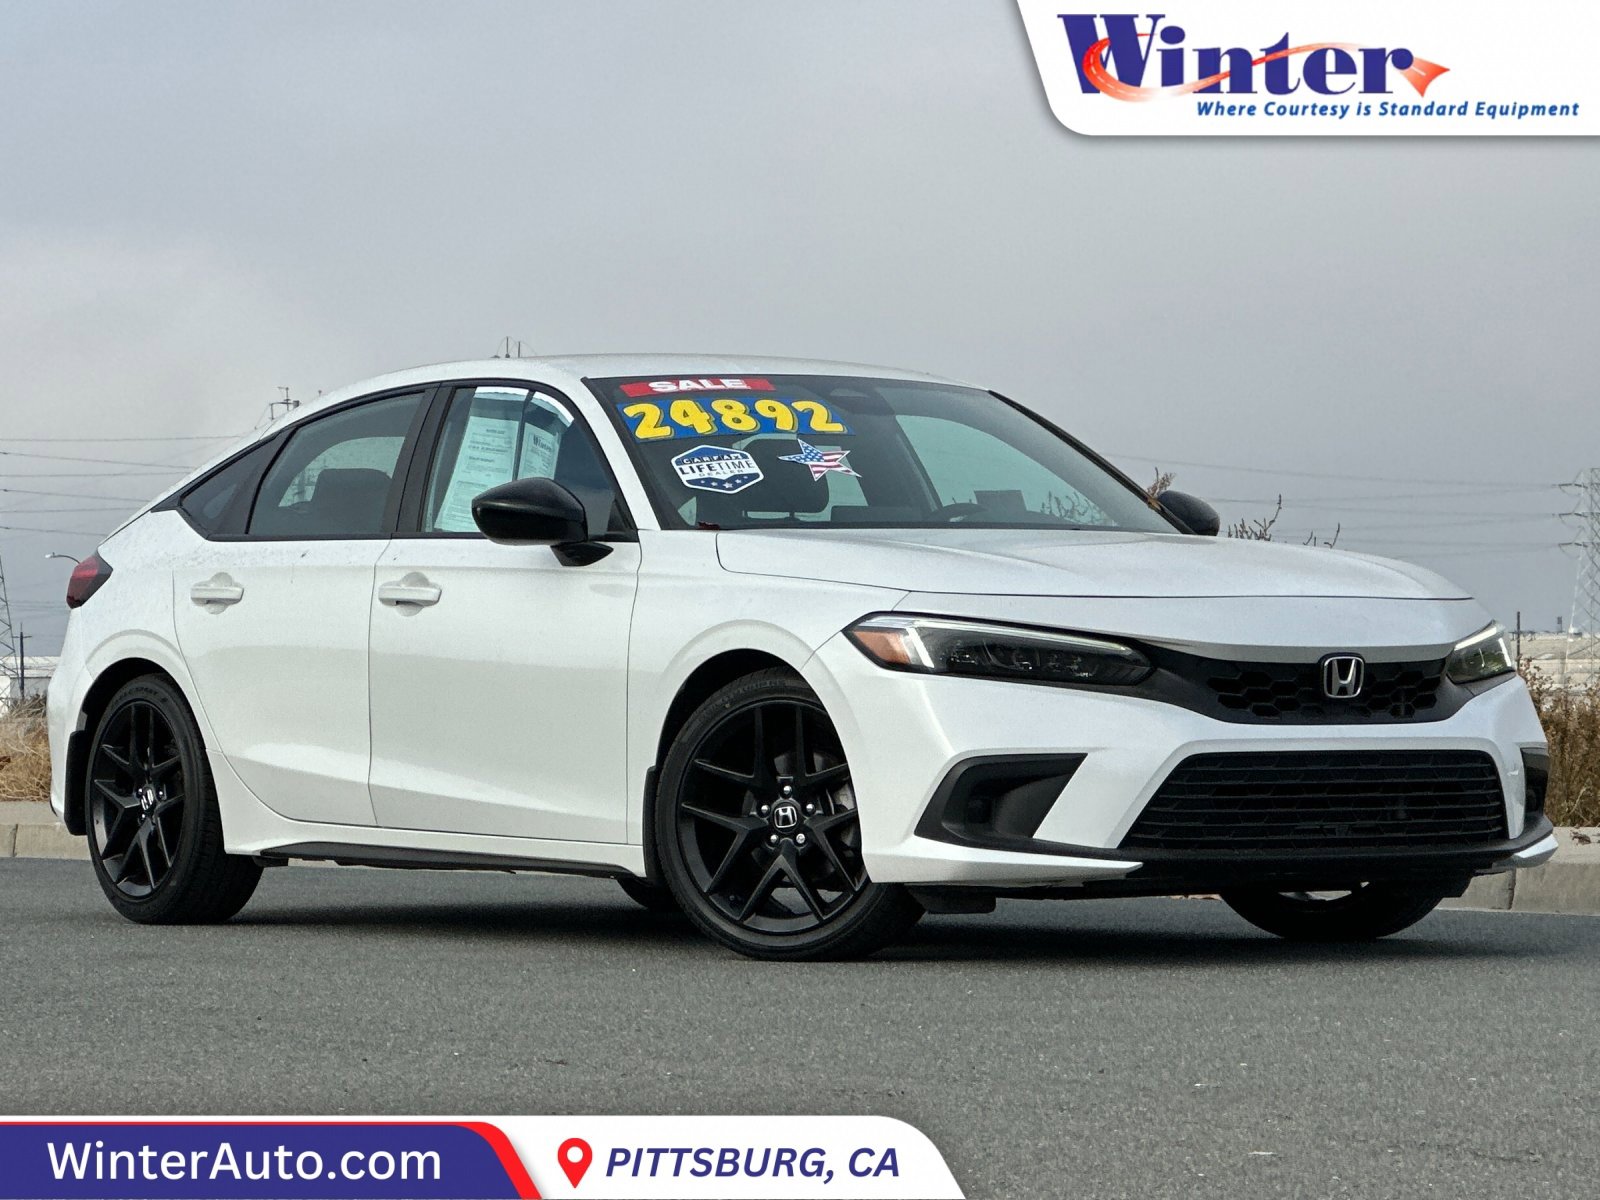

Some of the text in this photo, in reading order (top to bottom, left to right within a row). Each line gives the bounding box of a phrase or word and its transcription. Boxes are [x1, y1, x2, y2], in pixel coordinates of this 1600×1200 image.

[648, 378, 752, 393] SALE
[623, 399, 847, 440] 24892
[682, 453, 742, 464] CARFAX
[678, 461, 755, 475] LIFETIME
[698, 469, 744, 477] DEALER
